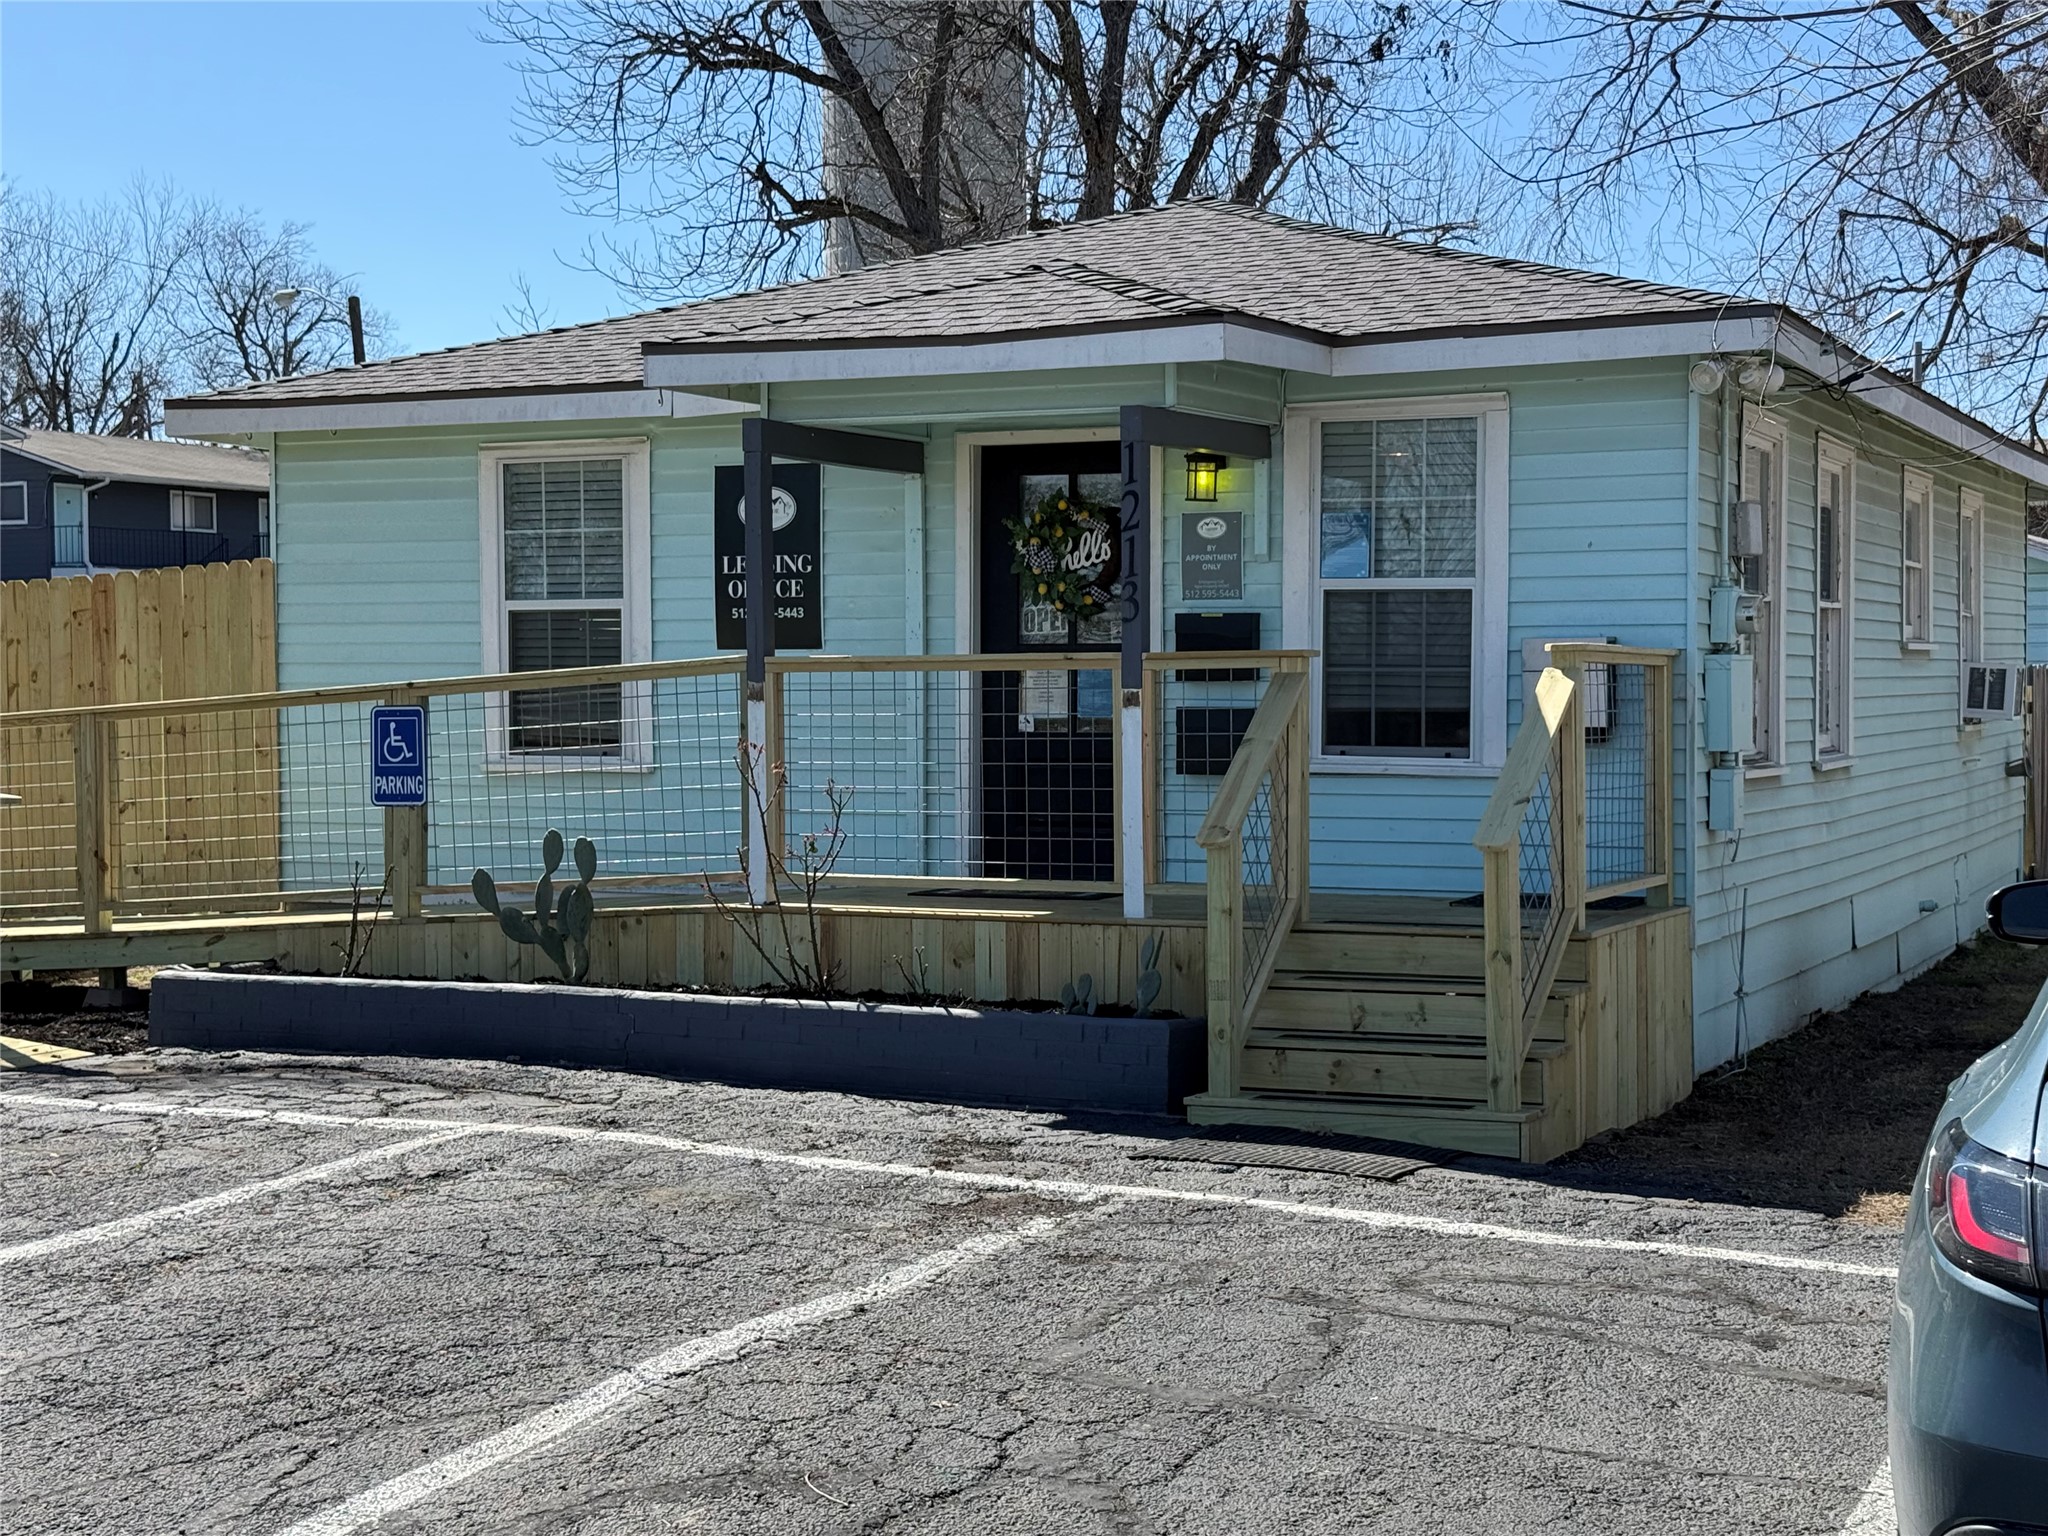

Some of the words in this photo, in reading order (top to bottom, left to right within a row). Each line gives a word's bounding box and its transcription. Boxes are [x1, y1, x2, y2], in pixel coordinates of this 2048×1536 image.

[1121, 442, 1140, 623] 1213
[1060, 528, 1112, 572] hello
[1185, 553, 1238, 562] APPOINTMENT
[1206, 544, 1217, 552] BY
[722, 554, 812, 574] LEING
[1202, 563, 1222, 571] ONLY
[728, 579, 804, 598] OCE
[1185, 589, 1200, 599] 512
[1201, 588, 1240, 599] 595-5443
[375, 775, 423, 795] PARKING
